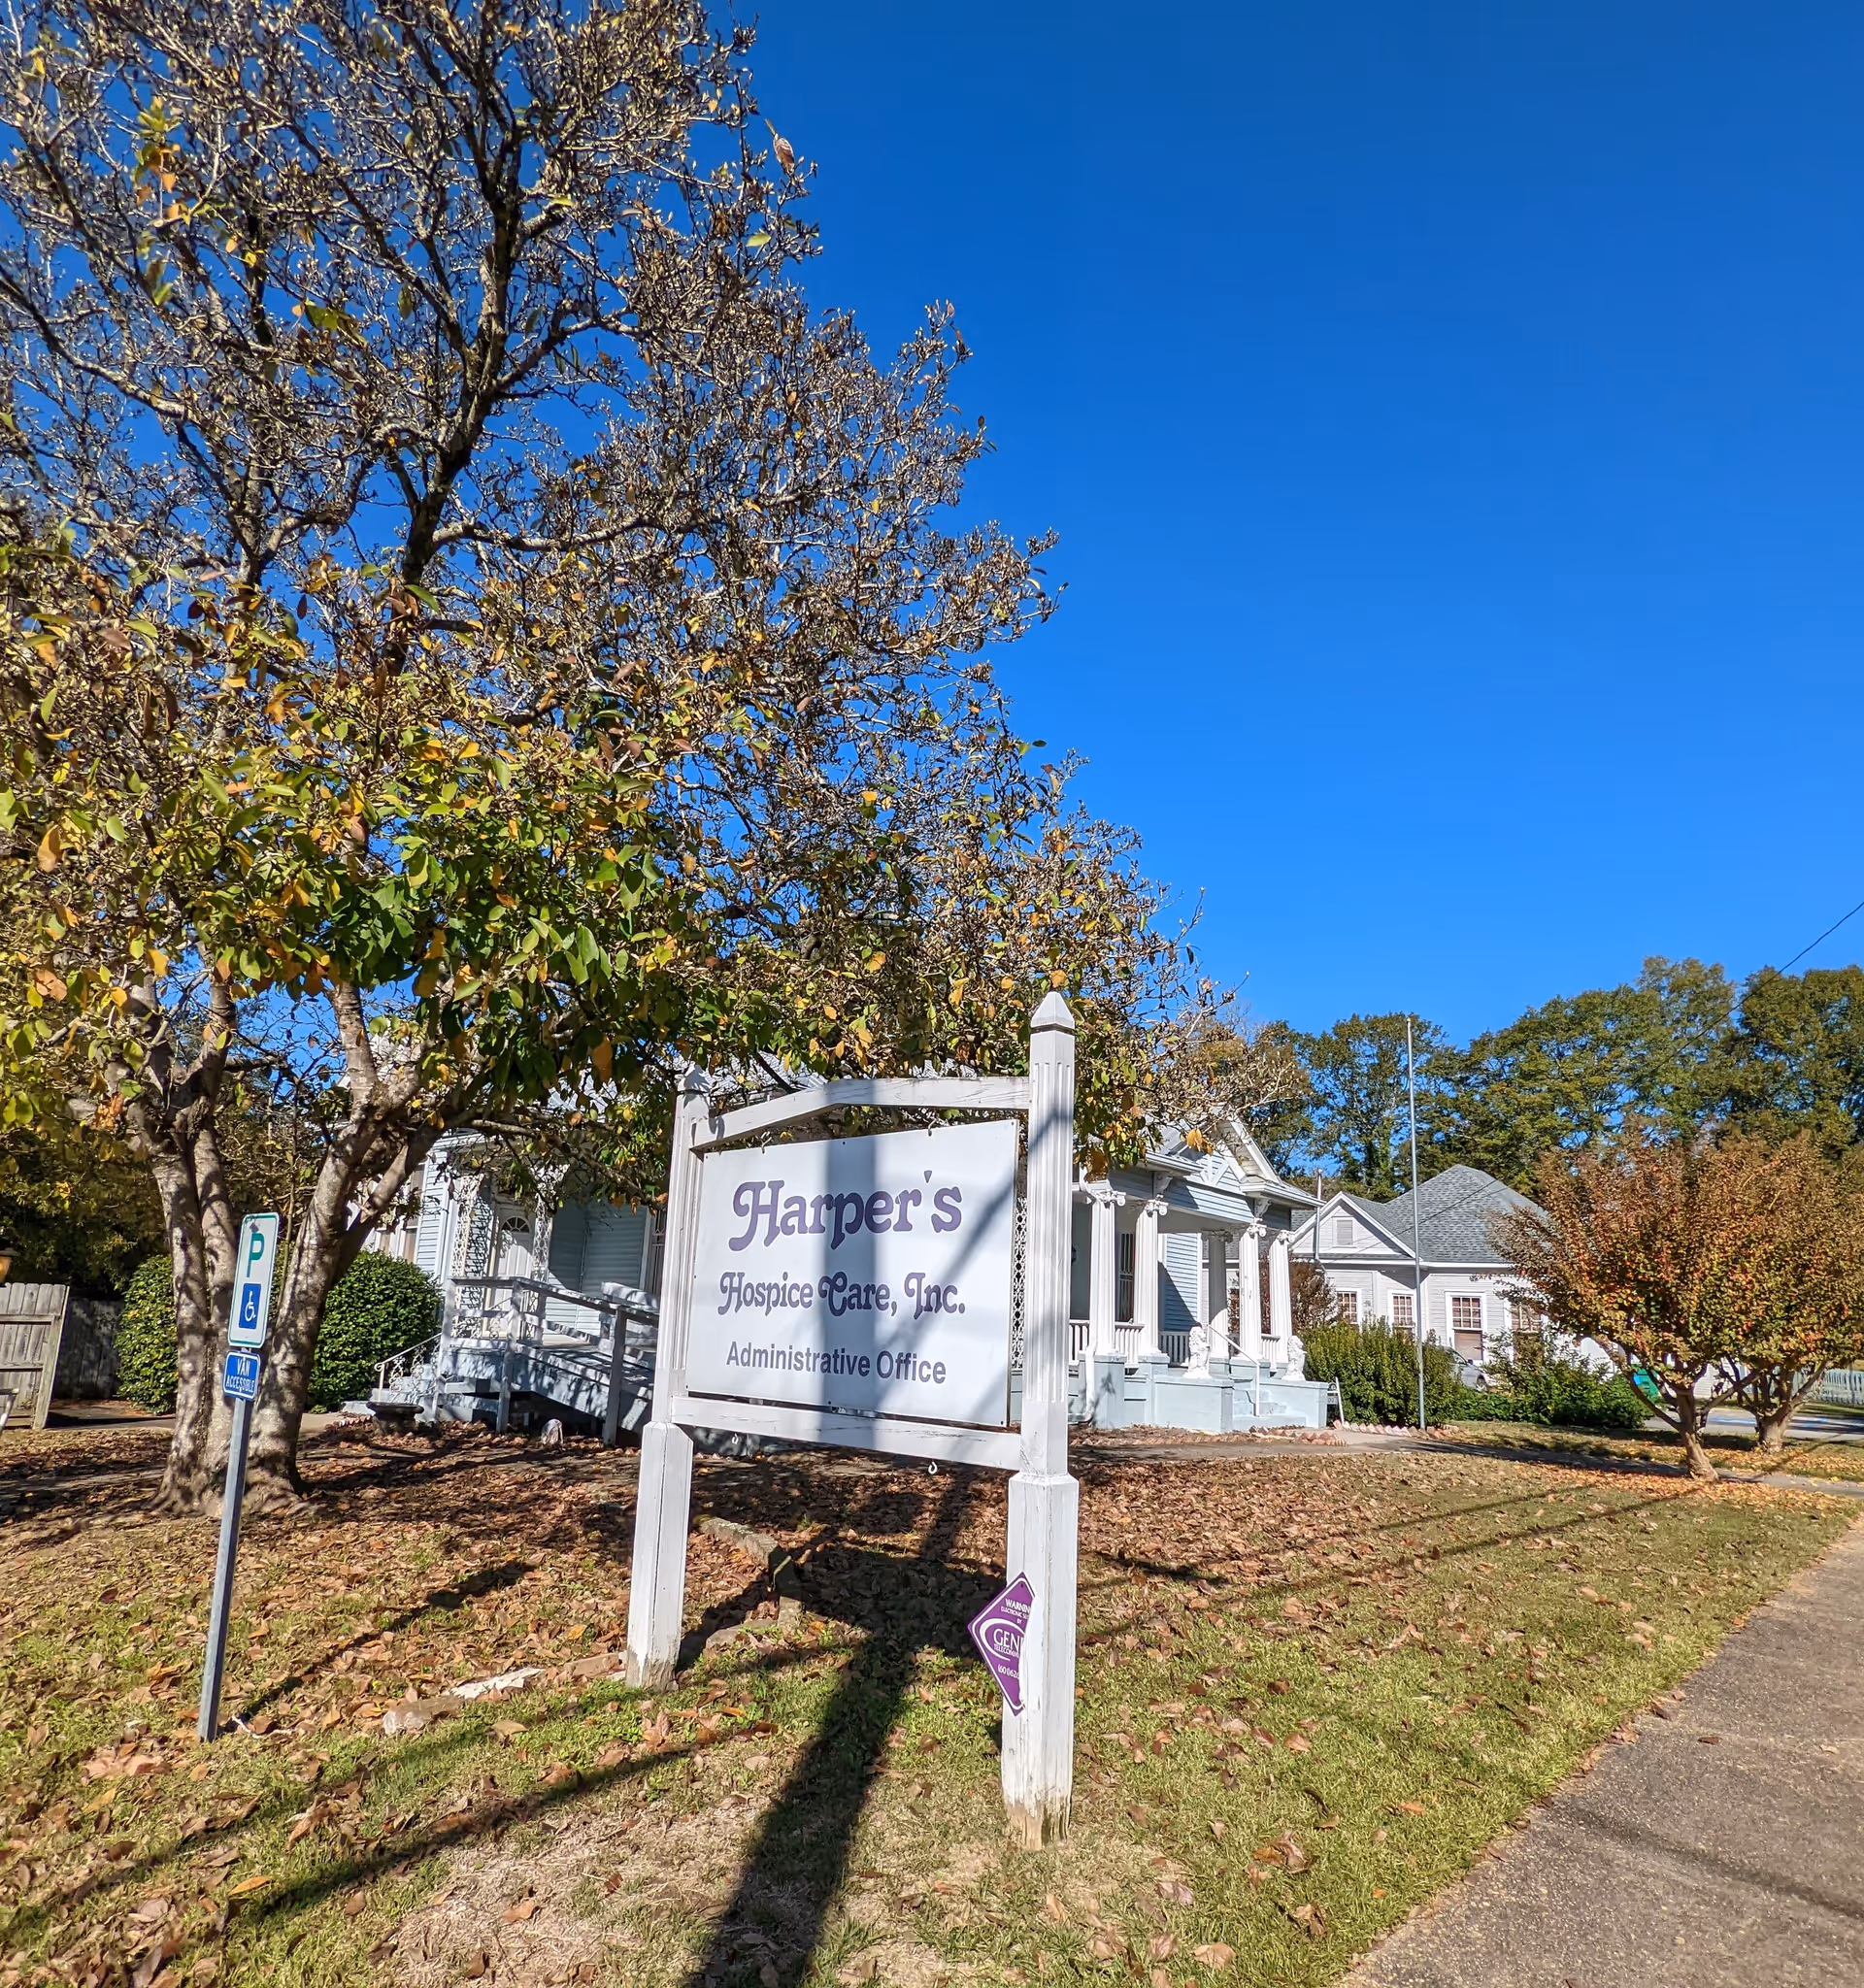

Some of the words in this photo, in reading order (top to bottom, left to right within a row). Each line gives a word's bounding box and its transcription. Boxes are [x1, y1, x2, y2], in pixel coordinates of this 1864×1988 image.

[728, 1170, 962, 1251] Harper's
[246, 1232, 265, 1278] P
[717, 1272, 814, 1316] Hospice
[818, 1272, 897, 1316] Care,
[904, 1273, 966, 1320] Inc.
[225, 1375, 254, 1393] ACCESSIBLE
[237, 1358, 250, 1376] VAN
[726, 1342, 871, 1377] Administrative
[876, 1350, 947, 1384] Office
